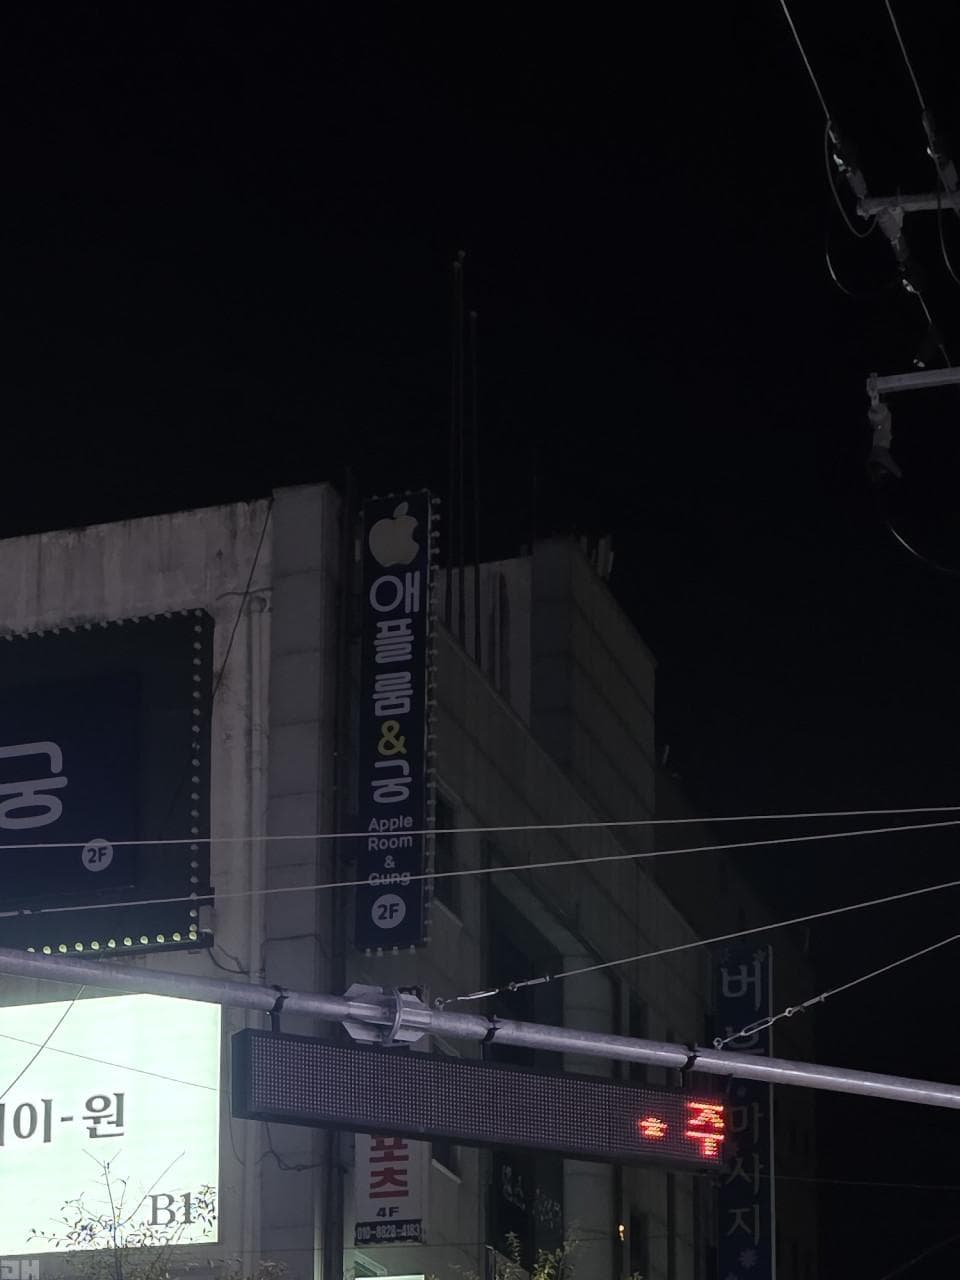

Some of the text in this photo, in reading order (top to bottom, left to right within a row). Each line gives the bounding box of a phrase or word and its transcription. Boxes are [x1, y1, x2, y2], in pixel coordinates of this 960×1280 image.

[367, 814, 414, 834] Apple
[367, 834, 414, 851] Room
[86, 847, 108, 865] 2F
[383, 855, 396, 869] &
[376, 902, 400, 921] 2F
[147, 1191, 195, 1226] B1
[375, 1206, 400, 1218] 4F
